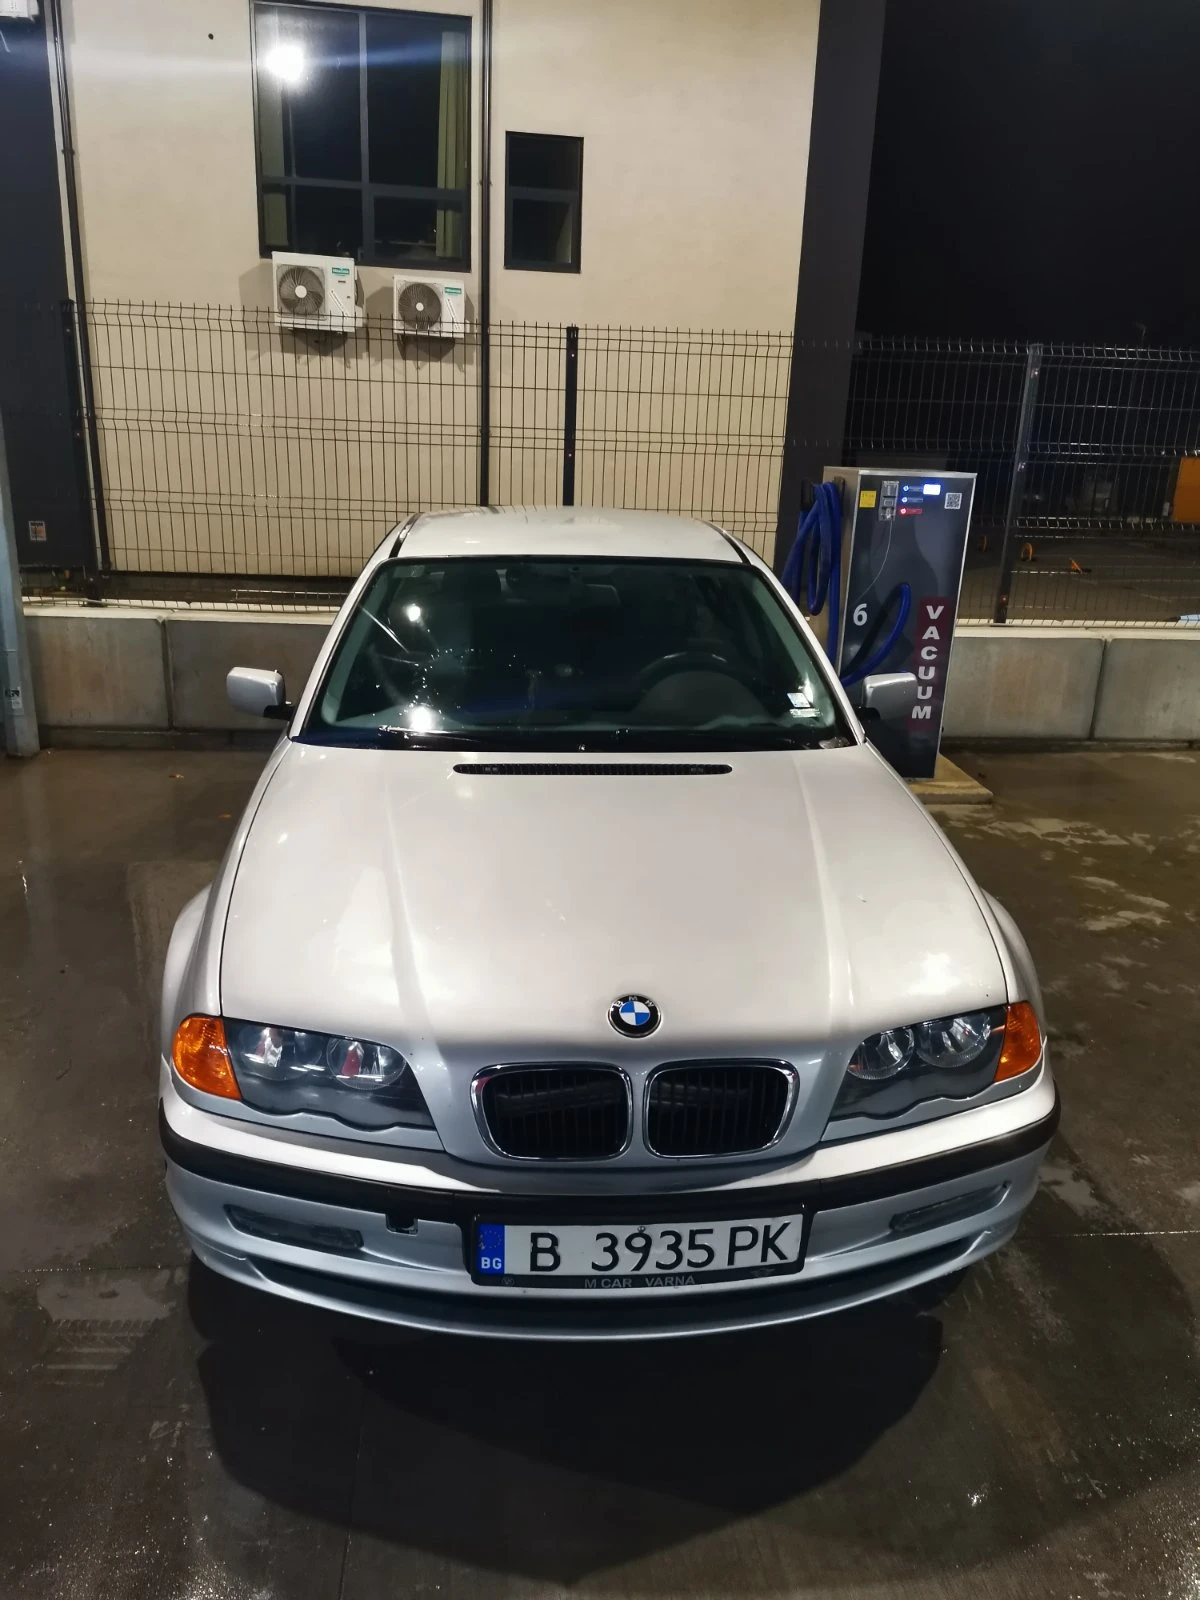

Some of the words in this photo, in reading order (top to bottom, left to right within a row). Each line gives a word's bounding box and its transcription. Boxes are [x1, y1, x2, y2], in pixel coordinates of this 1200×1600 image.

[853, 603, 868, 626] 6
[912, 605, 944, 719] VACUUM
[529, 1231, 561, 1272] B
[591, 1228, 715, 1272] 3935
[727, 1221, 791, 1266] PK
[481, 1256, 502, 1269] BG
[584, 1279, 597, 1289] M
[601, 1278, 632, 1289] CAR
[645, 1275, 696, 1288] VARNA
